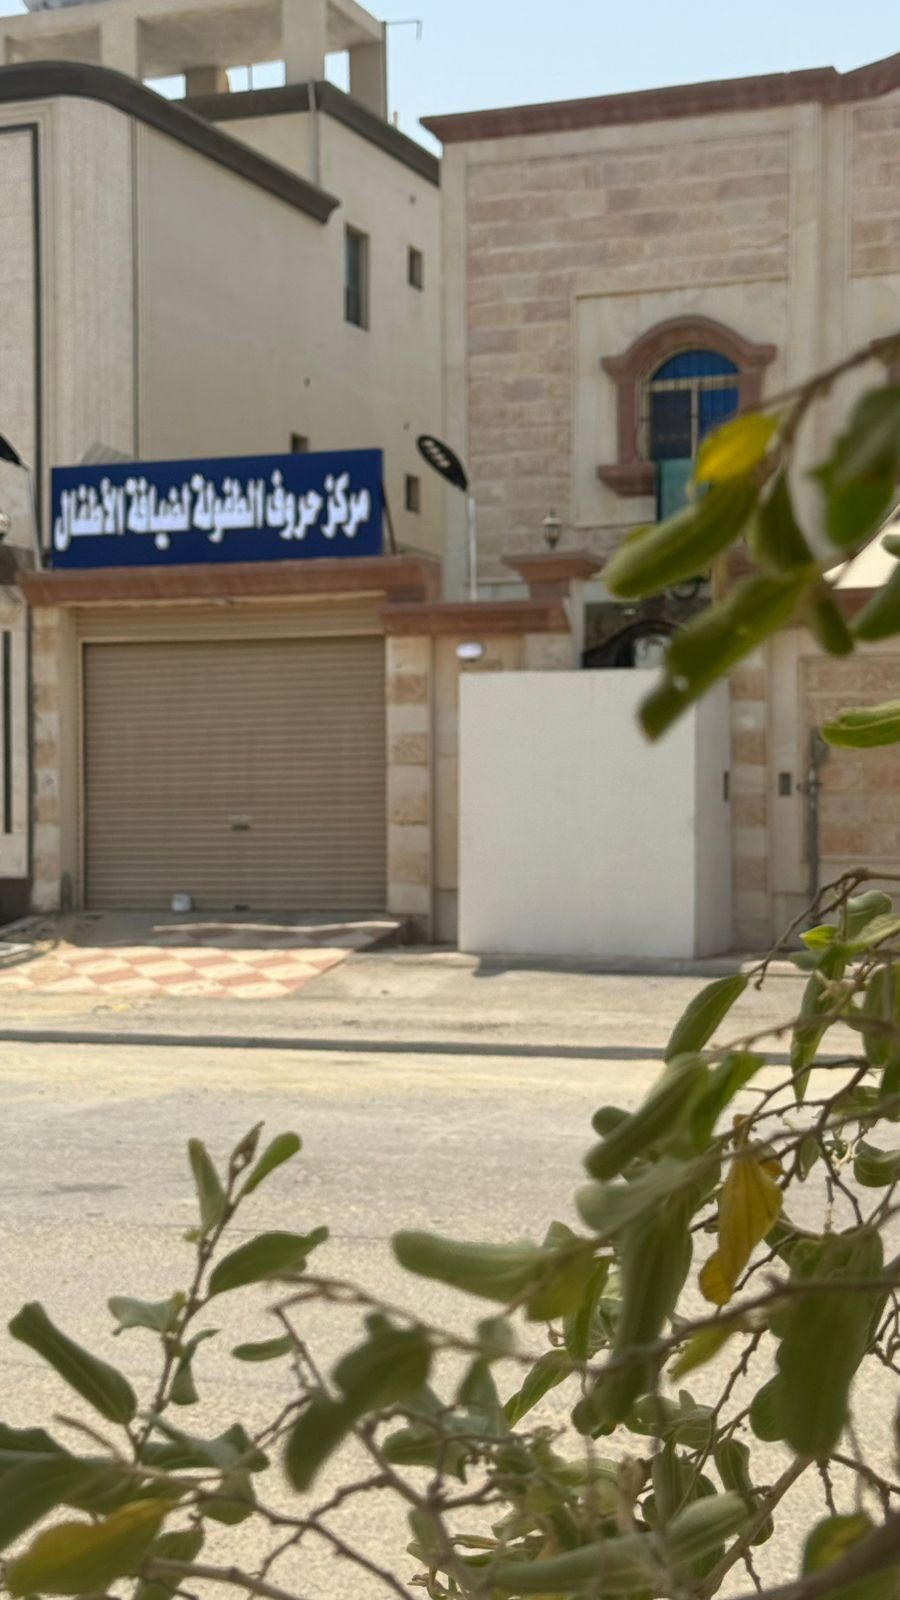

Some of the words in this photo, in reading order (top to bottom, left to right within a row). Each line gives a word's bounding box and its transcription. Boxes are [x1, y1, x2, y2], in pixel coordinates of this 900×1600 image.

[54, 476, 124, 551] الأطفال
[125, 476, 191, 550] لضيافة
[190, 473, 265, 543] الطفولة
[265, 468, 323, 540] حروف
[320, 472, 370, 538] مركز
